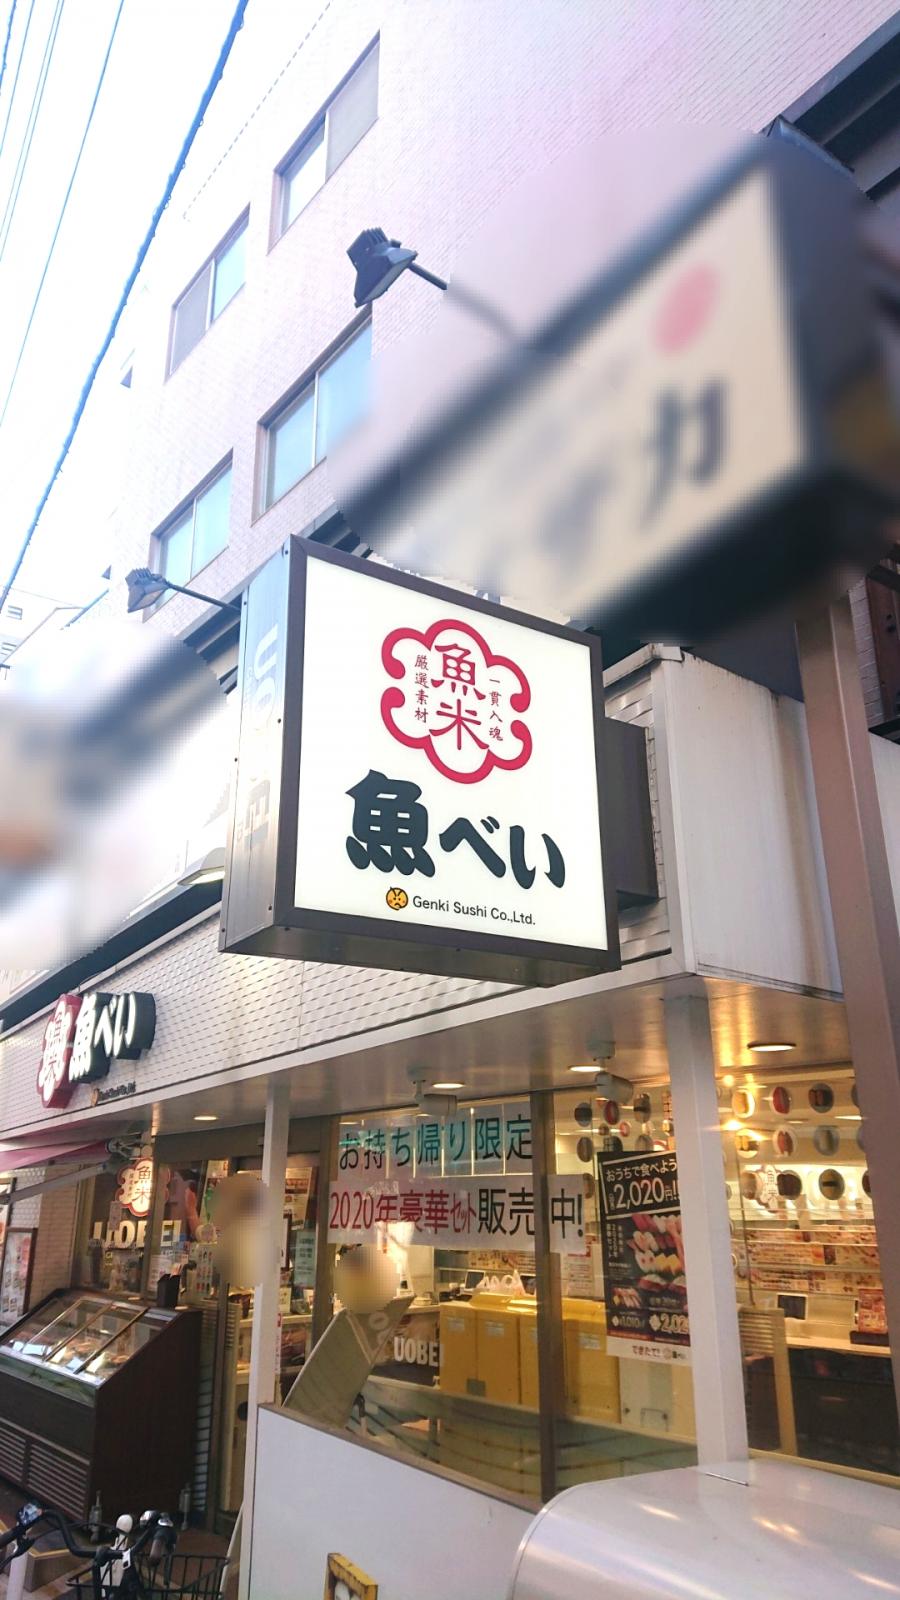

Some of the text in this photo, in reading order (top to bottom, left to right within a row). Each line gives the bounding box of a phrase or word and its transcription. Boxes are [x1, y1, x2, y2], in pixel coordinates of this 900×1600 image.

[413, 654, 430, 723] 厳選素材
[429, 643, 489, 750] 魚米
[489, 678, 504, 741] 一貫入魂
[345, 769, 566, 890] 魚べい
[412, 896, 536, 925] Genki Sushi Co.,Ltd.
[69, 991, 137, 1082] 魚べい
[339, 1114, 533, 1170] お持ち帰り限定
[614, 1177, 680, 1210] 2,020円!
